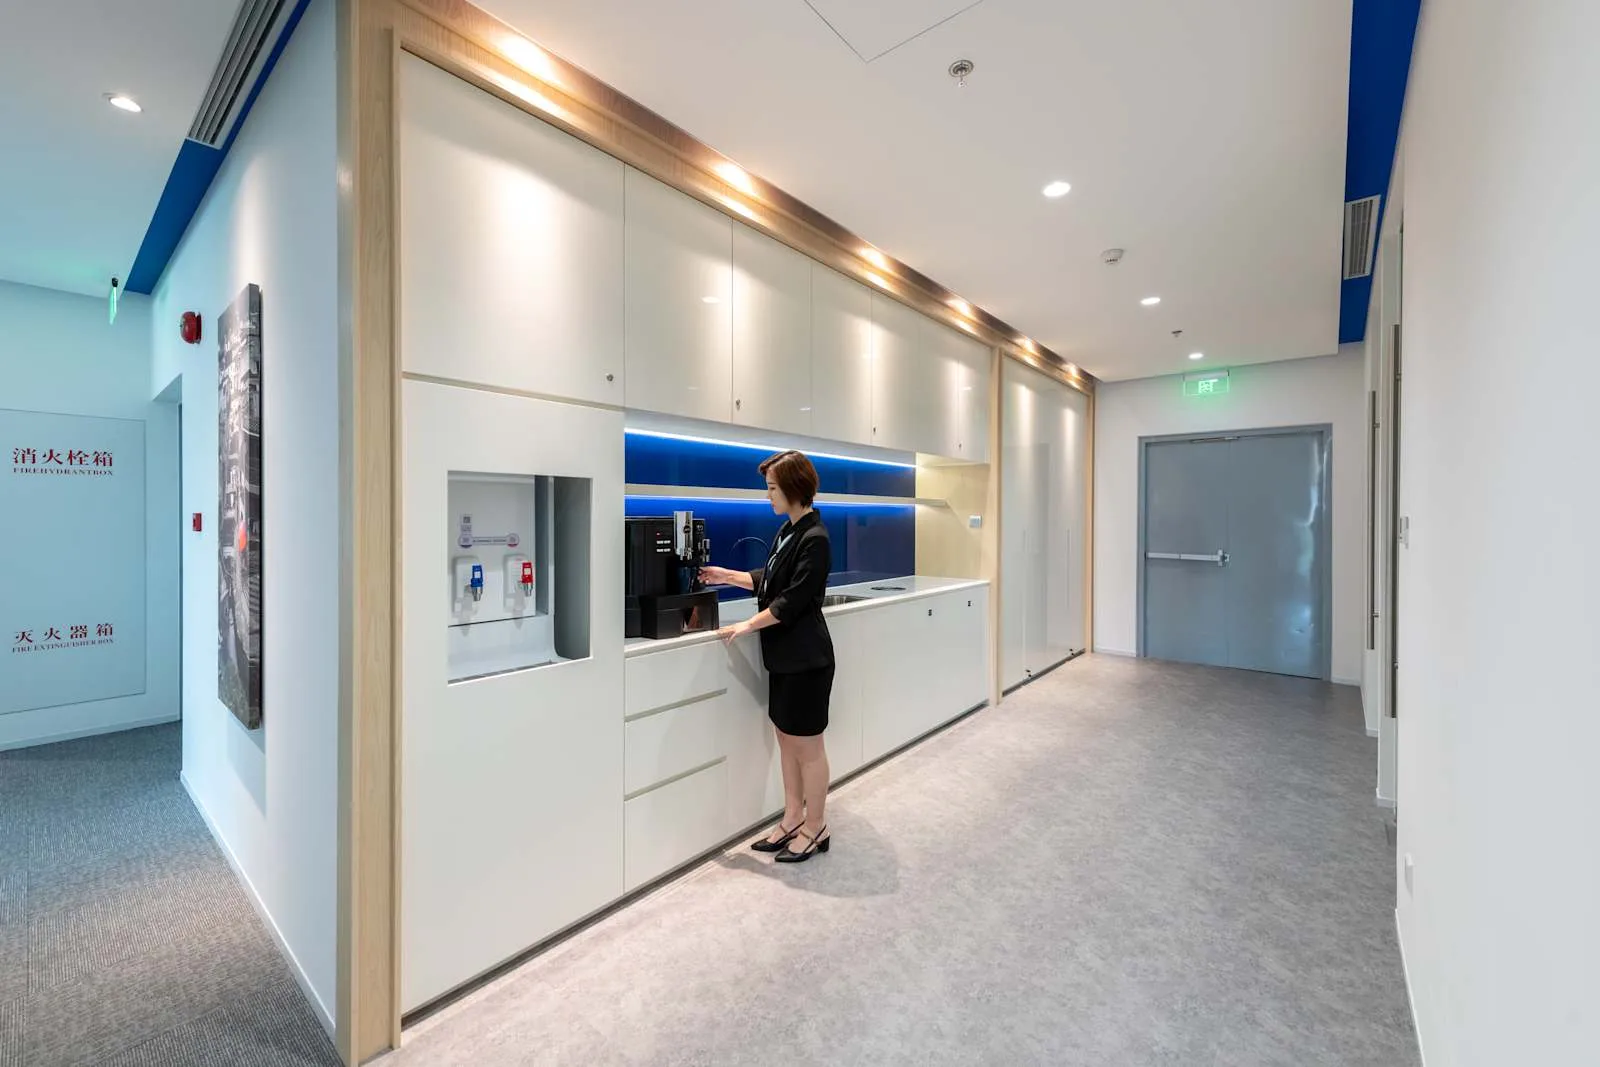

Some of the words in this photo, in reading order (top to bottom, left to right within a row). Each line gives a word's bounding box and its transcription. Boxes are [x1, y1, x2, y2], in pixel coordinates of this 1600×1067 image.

[13, 448, 113, 466] 消火栓箱
[15, 623, 113, 644] 灭火器箱
[12, 645, 32, 653] FIRE
